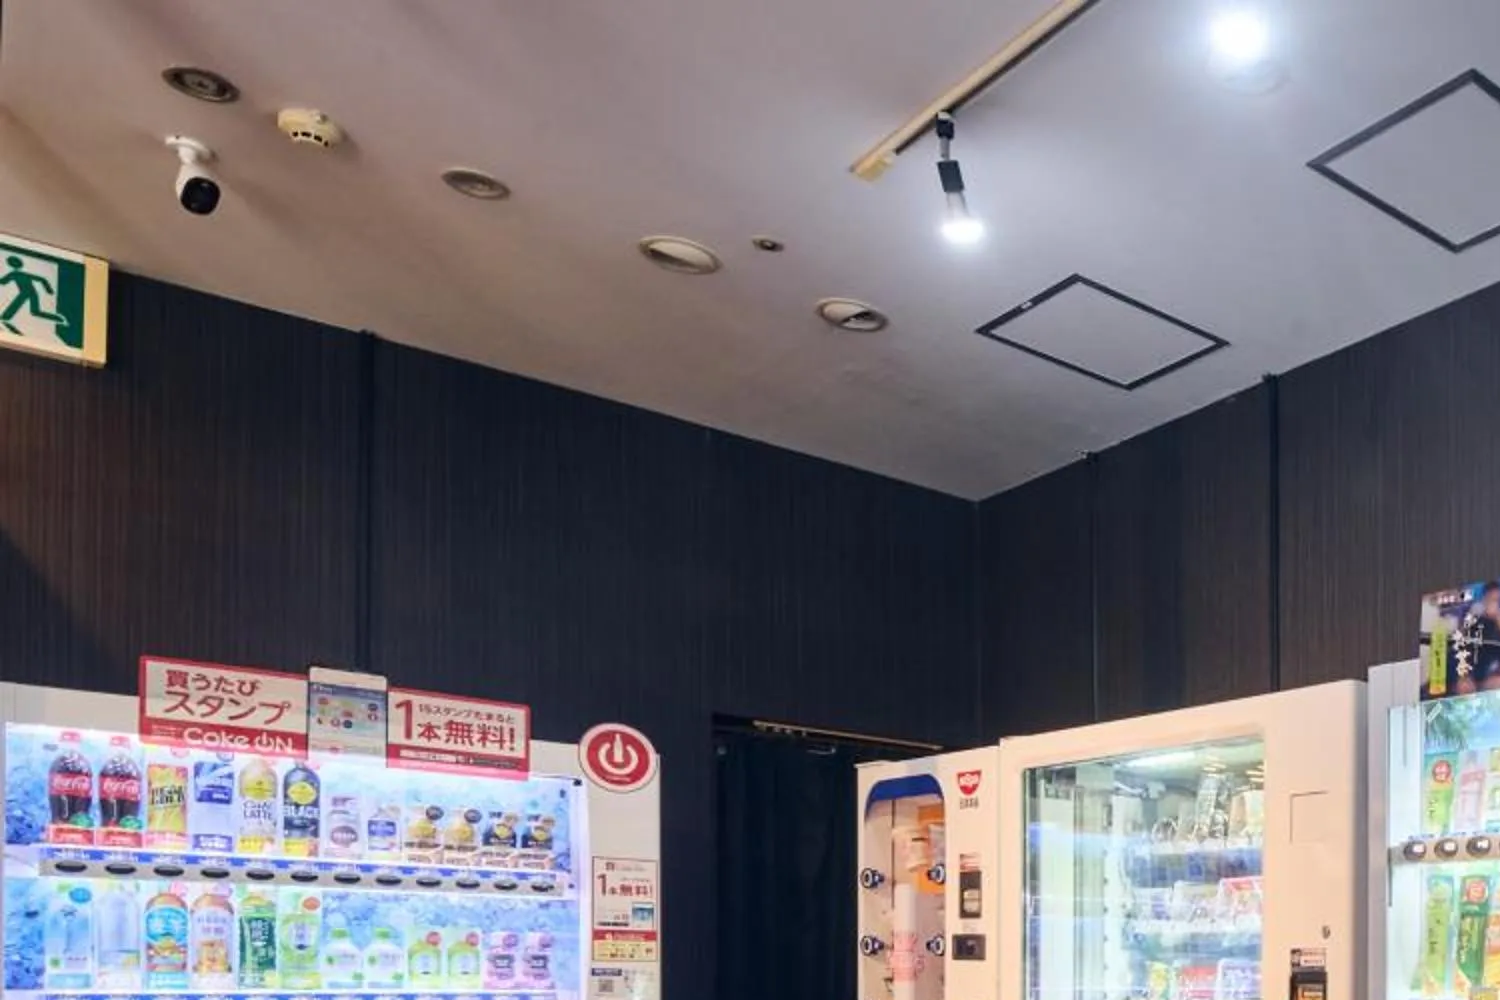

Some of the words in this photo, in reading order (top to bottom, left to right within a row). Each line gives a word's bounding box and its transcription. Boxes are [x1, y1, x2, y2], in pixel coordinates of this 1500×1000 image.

[165, 669, 262, 696] 買うたび
[163, 690, 292, 725] スタンプ
[183, 727, 250, 750] Coke
